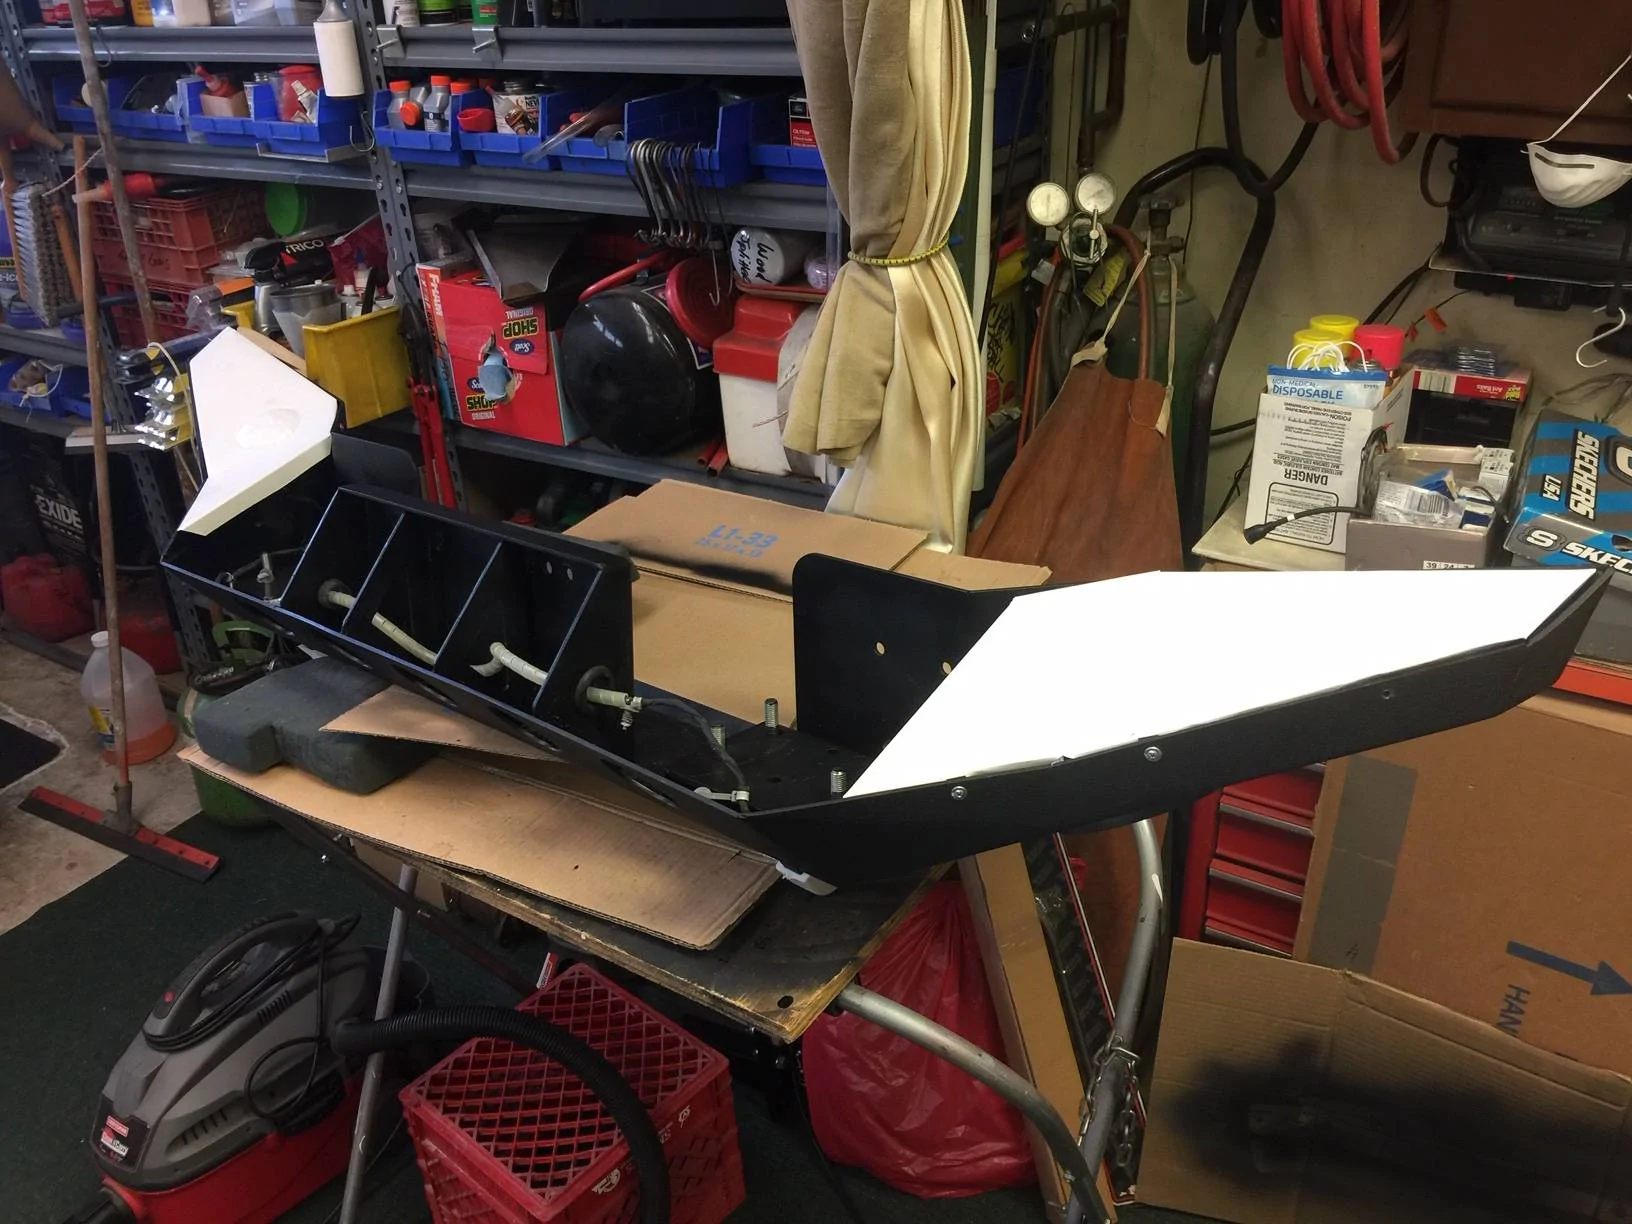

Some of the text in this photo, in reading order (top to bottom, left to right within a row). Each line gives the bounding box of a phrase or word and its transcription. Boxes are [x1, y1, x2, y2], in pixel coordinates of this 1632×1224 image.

[285, 239, 325, 254] TRICO
[755, 242, 775, 284] Wood
[503, 317, 538, 338] SHOP
[1272, 385, 1343, 399] DISPOSABLE
[1284, 468, 1328, 485] DANGER
[1569, 430, 1600, 520] SKECHERS
[1542, 474, 1562, 502] USA
[35, 494, 83, 529] EXIDE
